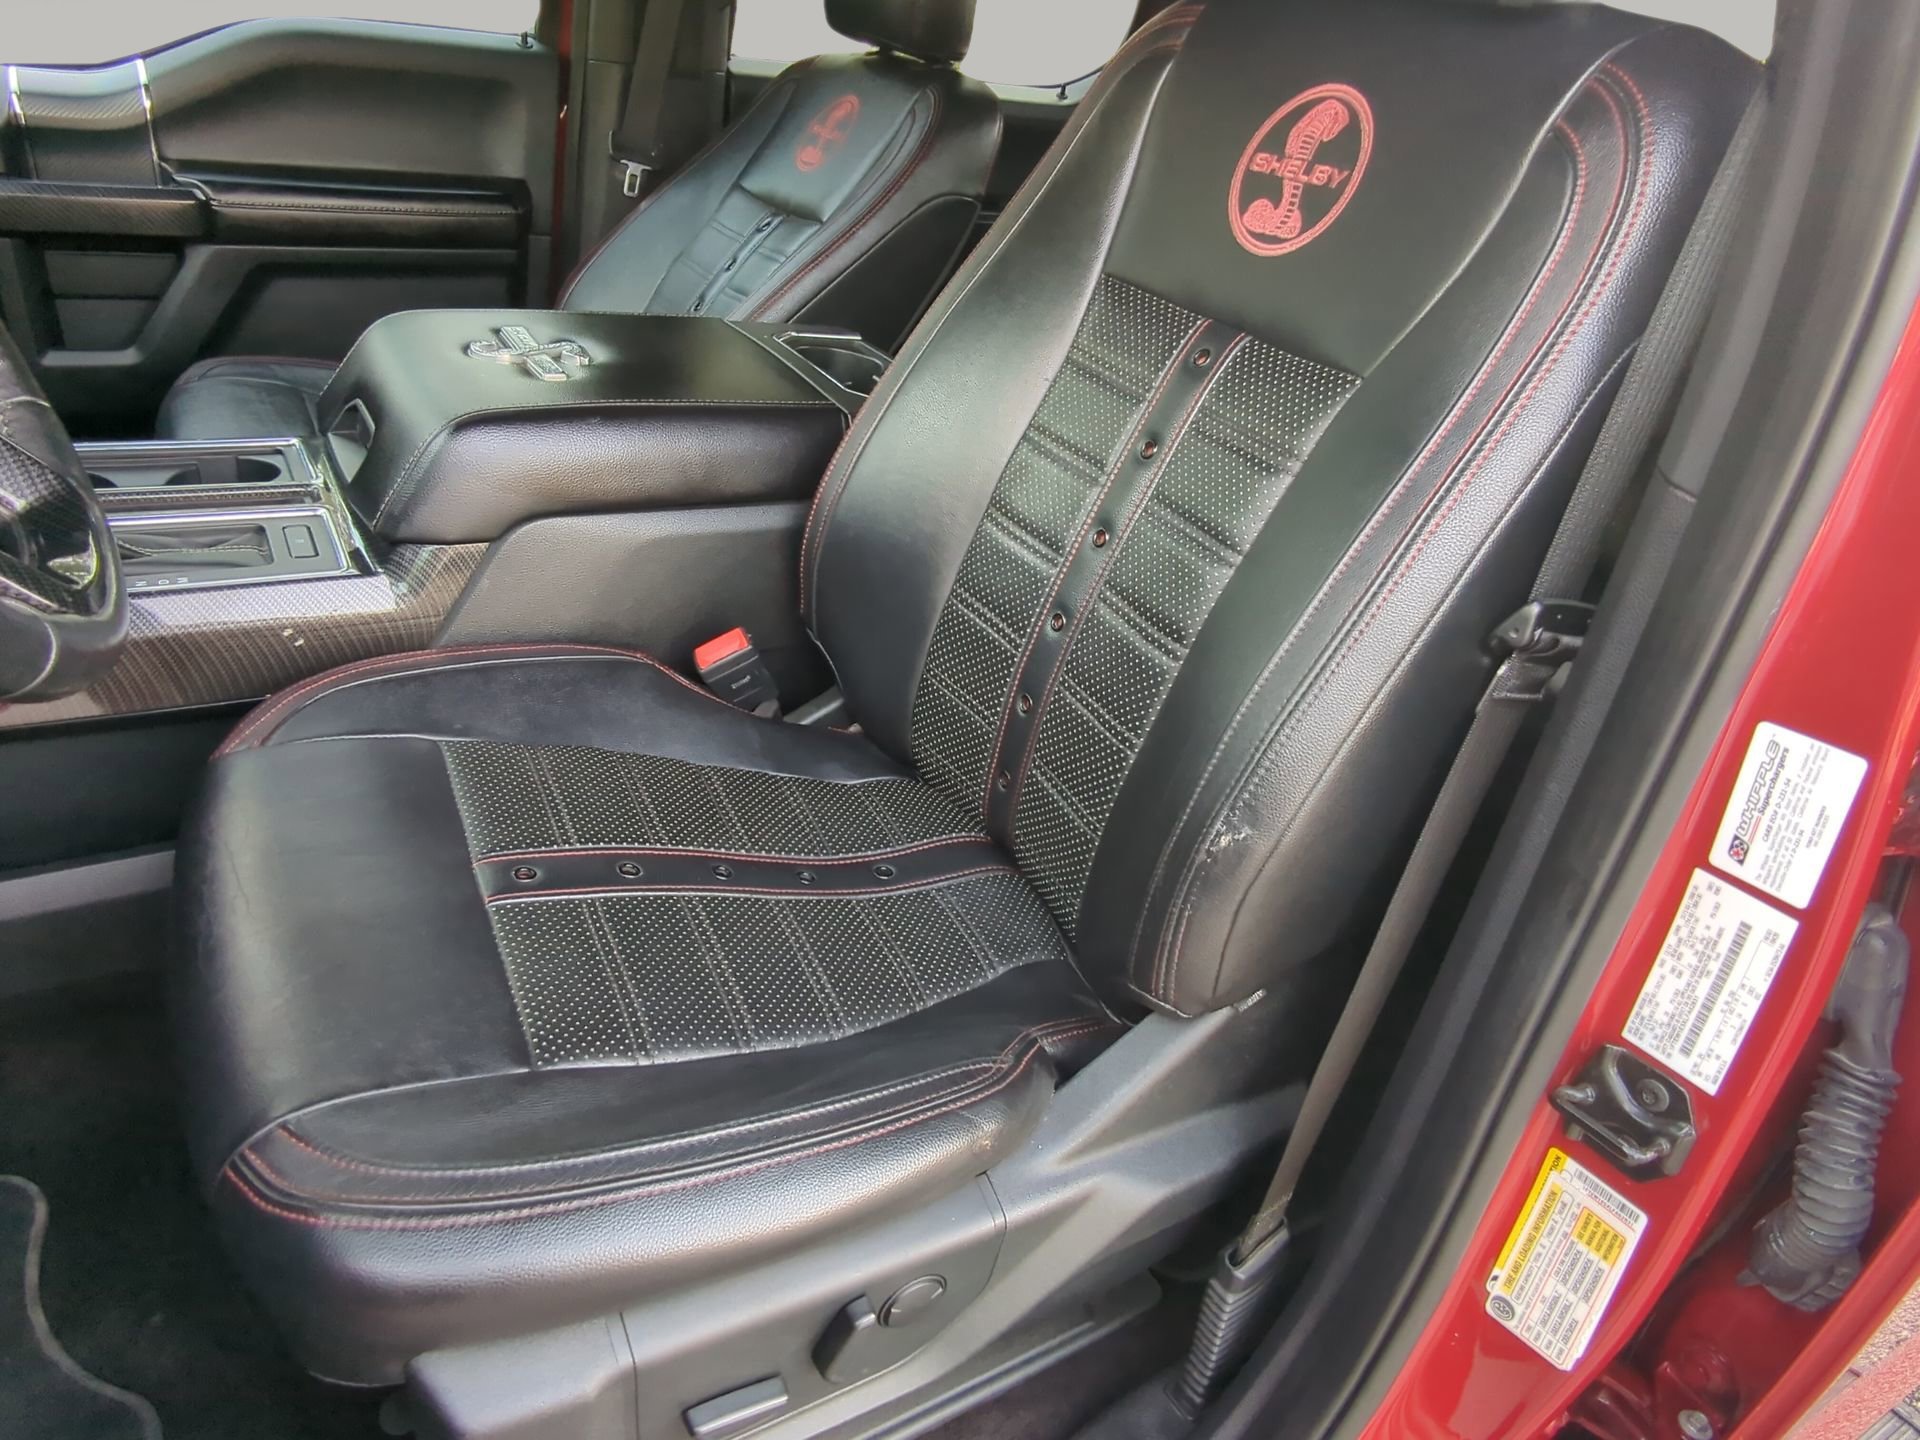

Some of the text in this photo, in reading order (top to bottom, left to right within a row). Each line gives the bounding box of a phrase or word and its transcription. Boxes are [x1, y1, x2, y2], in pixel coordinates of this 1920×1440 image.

[1249, 152, 1351, 189] SHELBY
[1734, 738, 1782, 838] WHIPPLE
[1756, 745, 1791, 816] Superchargers
[1503, 1272, 1515, 1289] TIRE
[1510, 1259, 1522, 1275] AND
[1516, 1231, 1537, 1262] LOADING
[1529, 1189, 1559, 1234] INFORMATION
